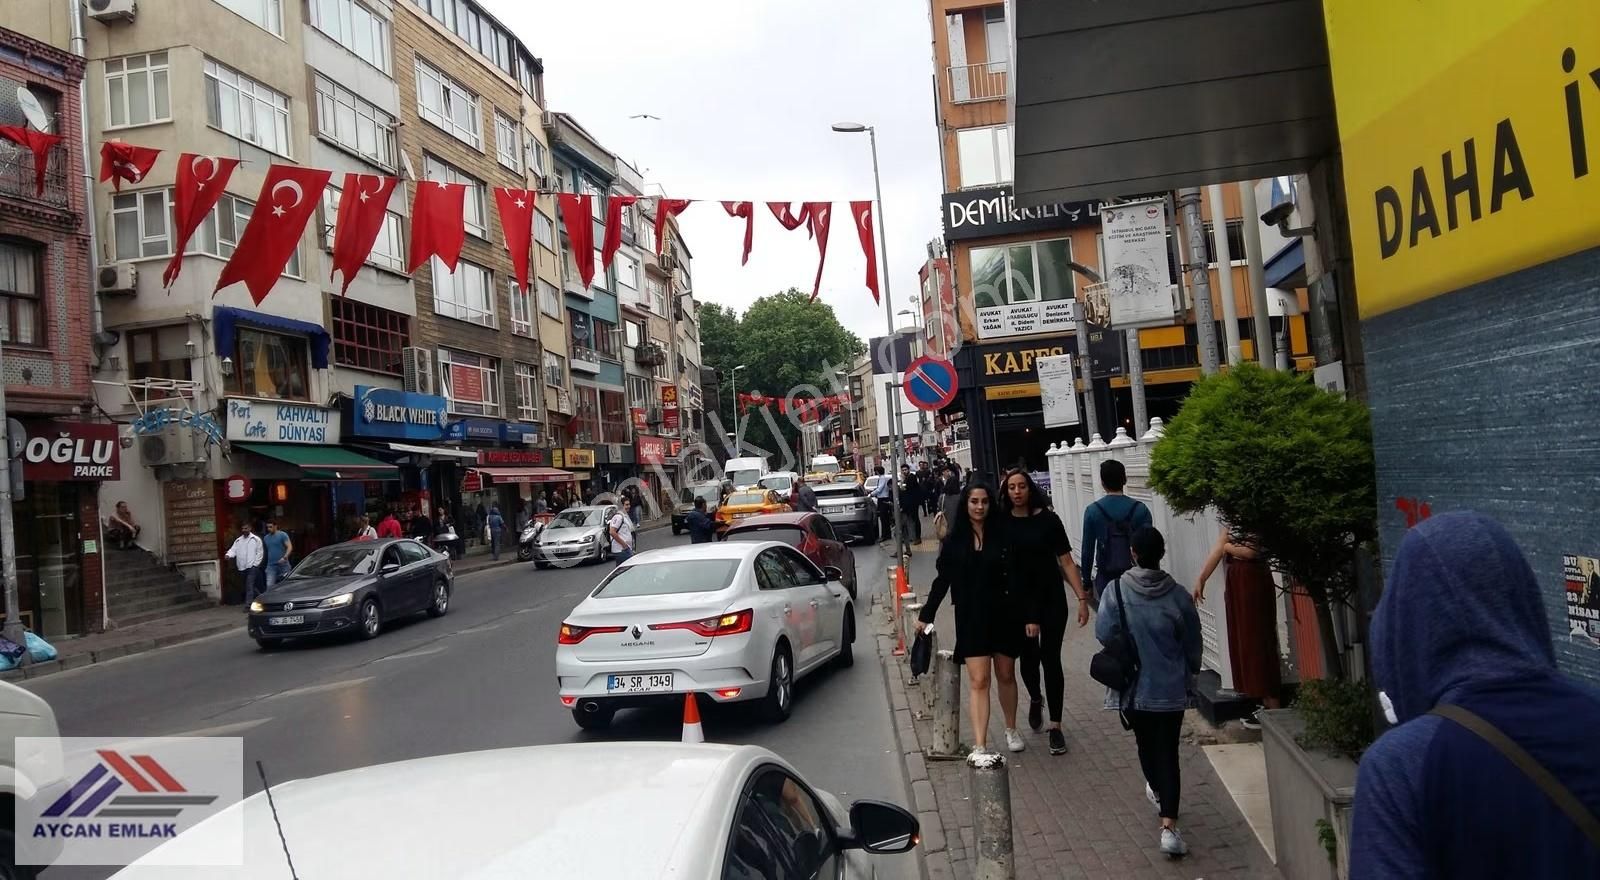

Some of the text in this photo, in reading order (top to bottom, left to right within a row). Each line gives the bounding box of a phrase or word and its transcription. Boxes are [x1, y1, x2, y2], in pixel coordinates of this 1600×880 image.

[1375, 118, 1535, 261] DAHA
[1562, 47, 1600, 180] İ
[276, 405, 330, 424] KAHVALTI
[377, 404, 437, 425] BLACK WHITE
[244, 420, 326, 442] Cafe DÜNYASI
[26, 432, 114, 463] OĞLU
[73, 465, 113, 477] PARKE
[1563, 556, 1577, 566] BU
[1567, 592, 1578, 602] 23
[615, 675, 671, 689] 34 SR 1349
